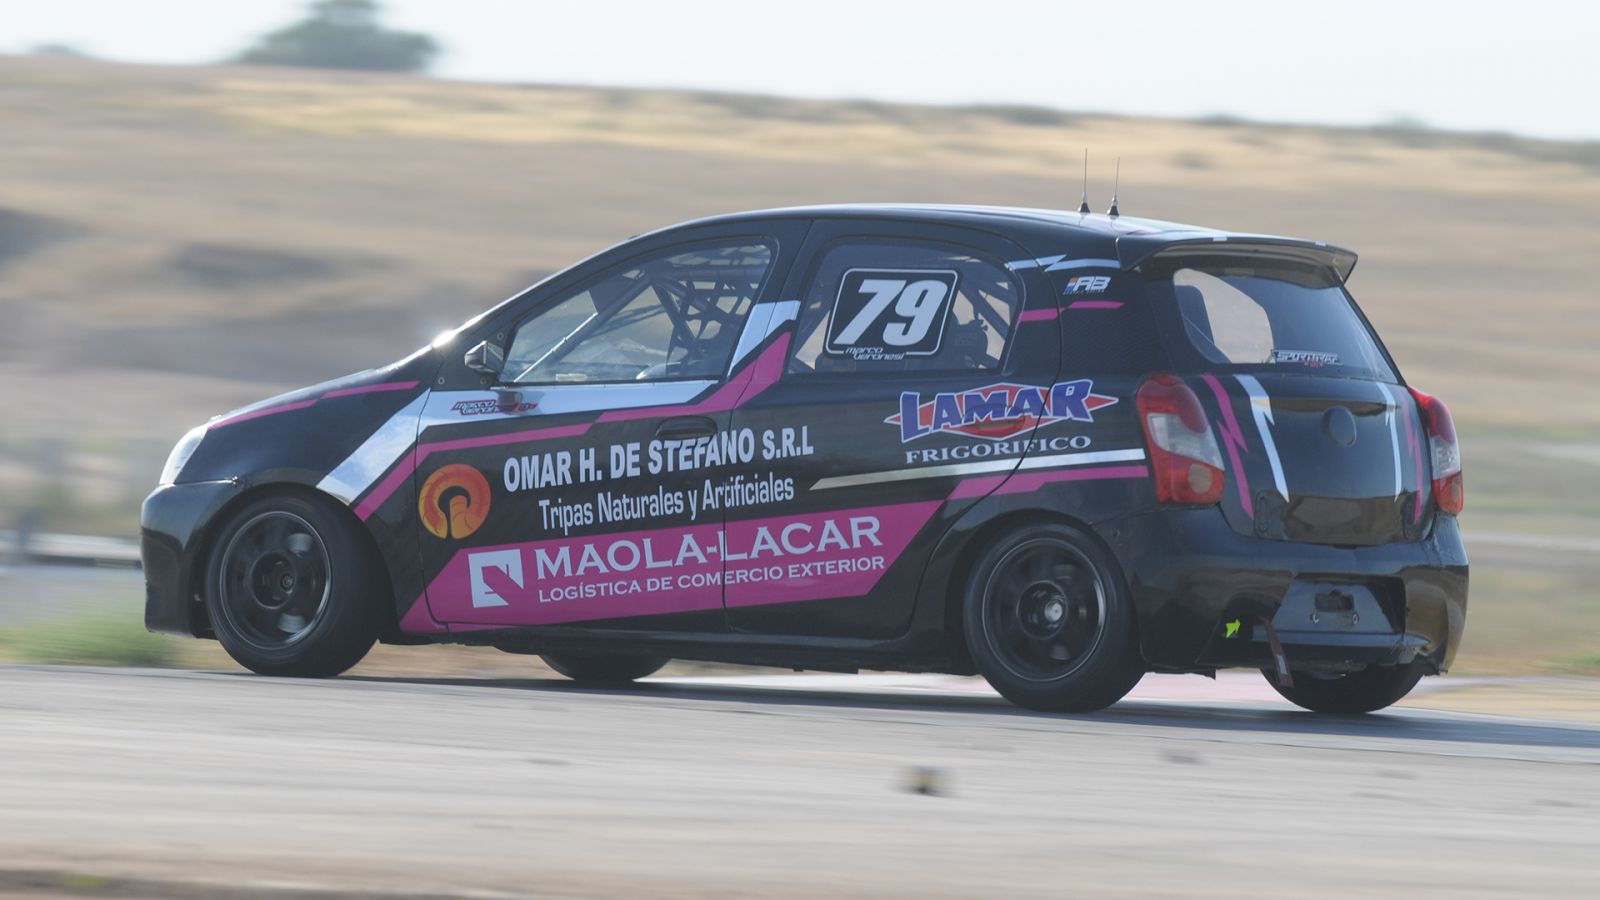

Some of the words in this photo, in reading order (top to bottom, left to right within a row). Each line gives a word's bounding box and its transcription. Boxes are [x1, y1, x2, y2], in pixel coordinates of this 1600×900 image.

[833, 279, 948, 346] 79
[899, 379, 1094, 443] LAMAR
[503, 450, 572, 492] OMAR
[579, 447, 603, 483] H.
[610, 442, 641, 479] DE
[648, 428, 754, 474] STEFANO
[762, 426, 813, 460] S.R.L
[905, 436, 1092, 464] FRIGORIFICO
[539, 498, 593, 536] Tripas
[598, 484, 684, 523] Naturales
[689, 489, 697, 520] y
[702, 473, 794, 511] Artificiales
[534, 516, 882, 580] MAOLA-LACAR
[538, 578, 642, 603] LOGÍSTICA
[645, 574, 673, 592] DE
[677, 564, 783, 588] COMERCIO
[788, 556, 885, 577] EXTERIOR
